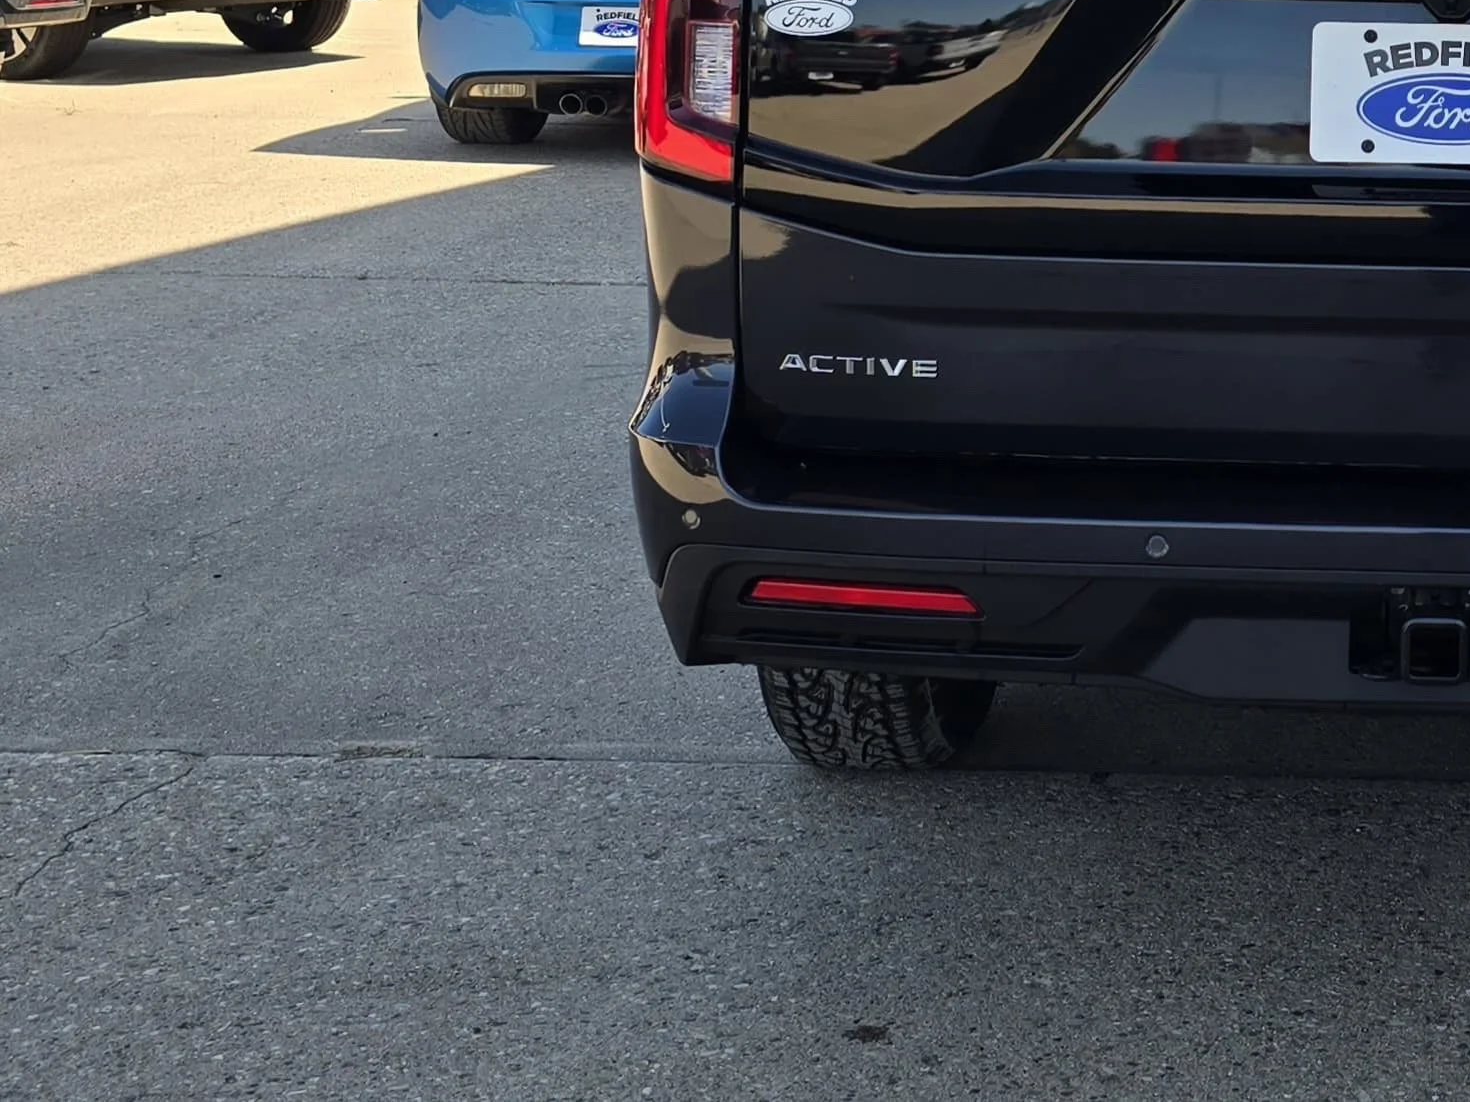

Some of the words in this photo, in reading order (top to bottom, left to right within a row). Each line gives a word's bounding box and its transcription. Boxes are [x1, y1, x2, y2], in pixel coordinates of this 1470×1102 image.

[595, 11, 640, 22] REDFIEL
[782, 5, 835, 29] Ford
[602, 22, 634, 37] Ford
[779, 353, 938, 379] ACTIVE
